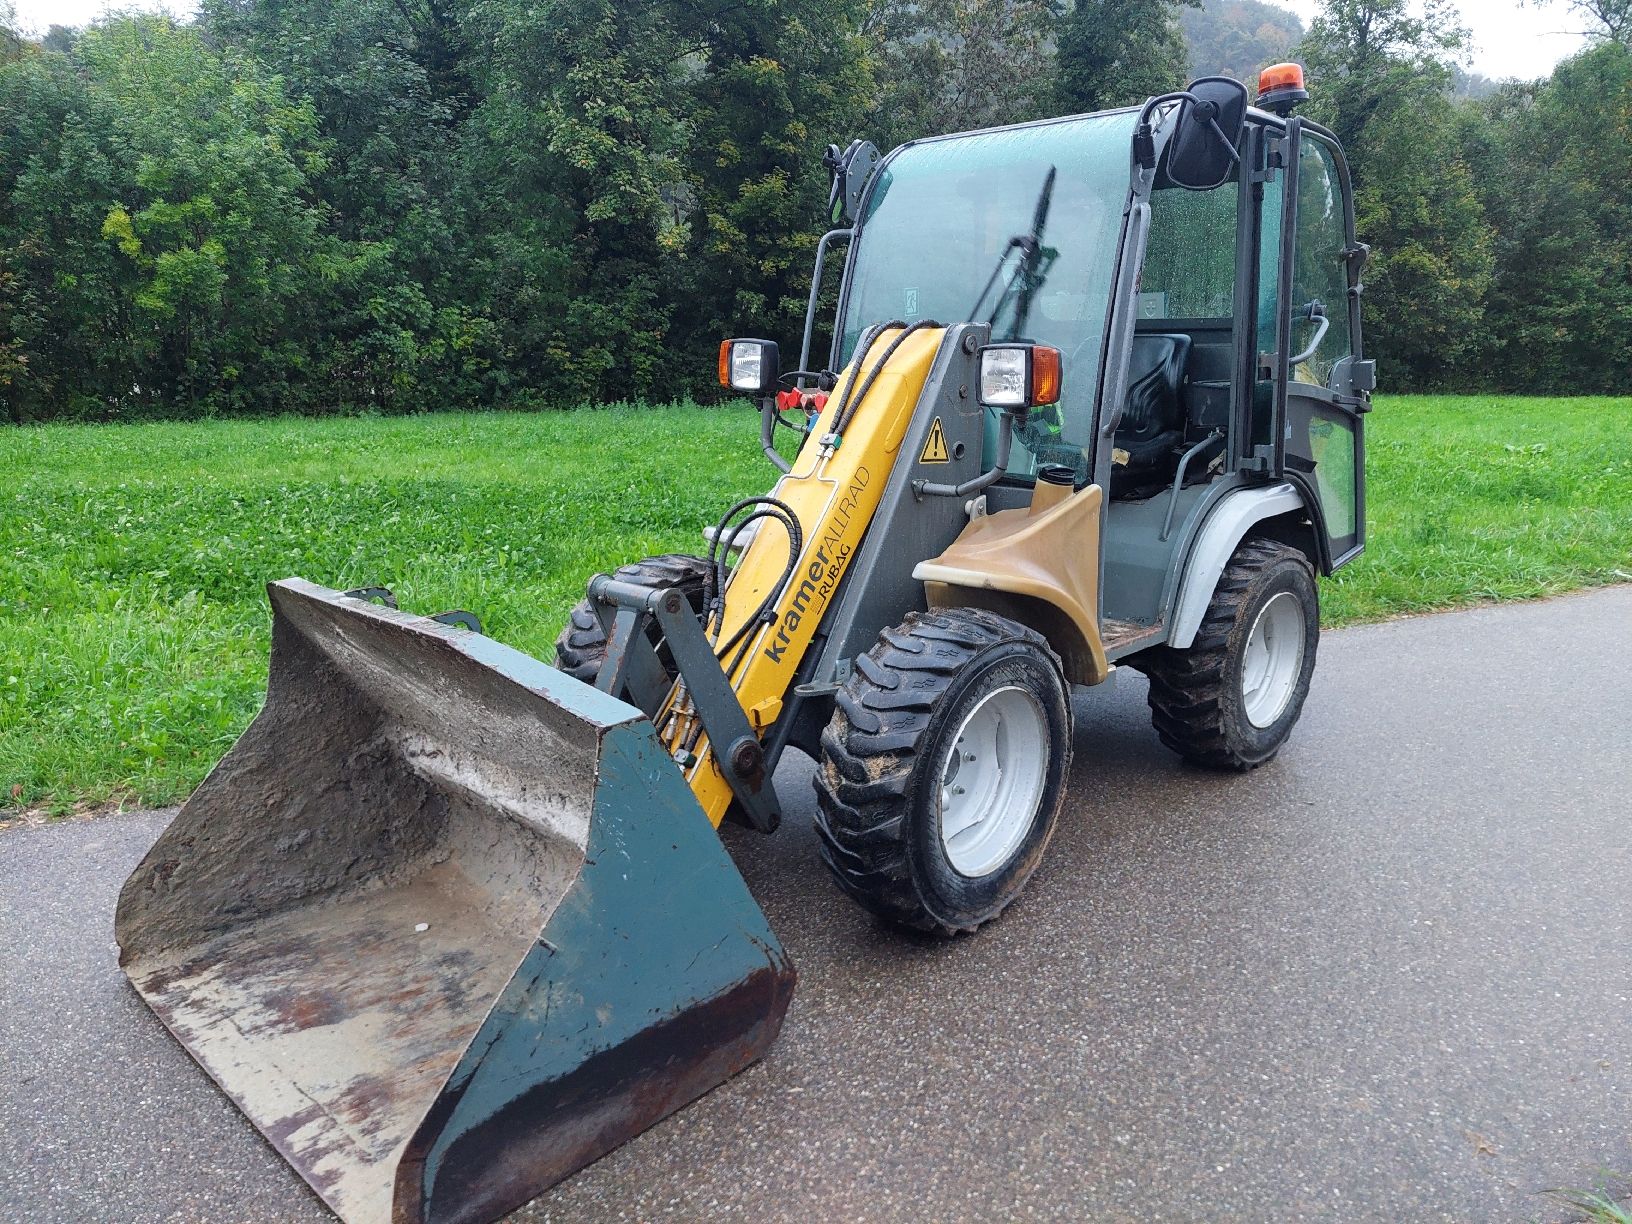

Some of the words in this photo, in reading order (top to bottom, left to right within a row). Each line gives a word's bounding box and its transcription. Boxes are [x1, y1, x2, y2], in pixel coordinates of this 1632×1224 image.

[764, 544, 829, 664] kramer
[824, 466, 870, 555] ALLRAD
[819, 543, 851, 600] RUBAG
